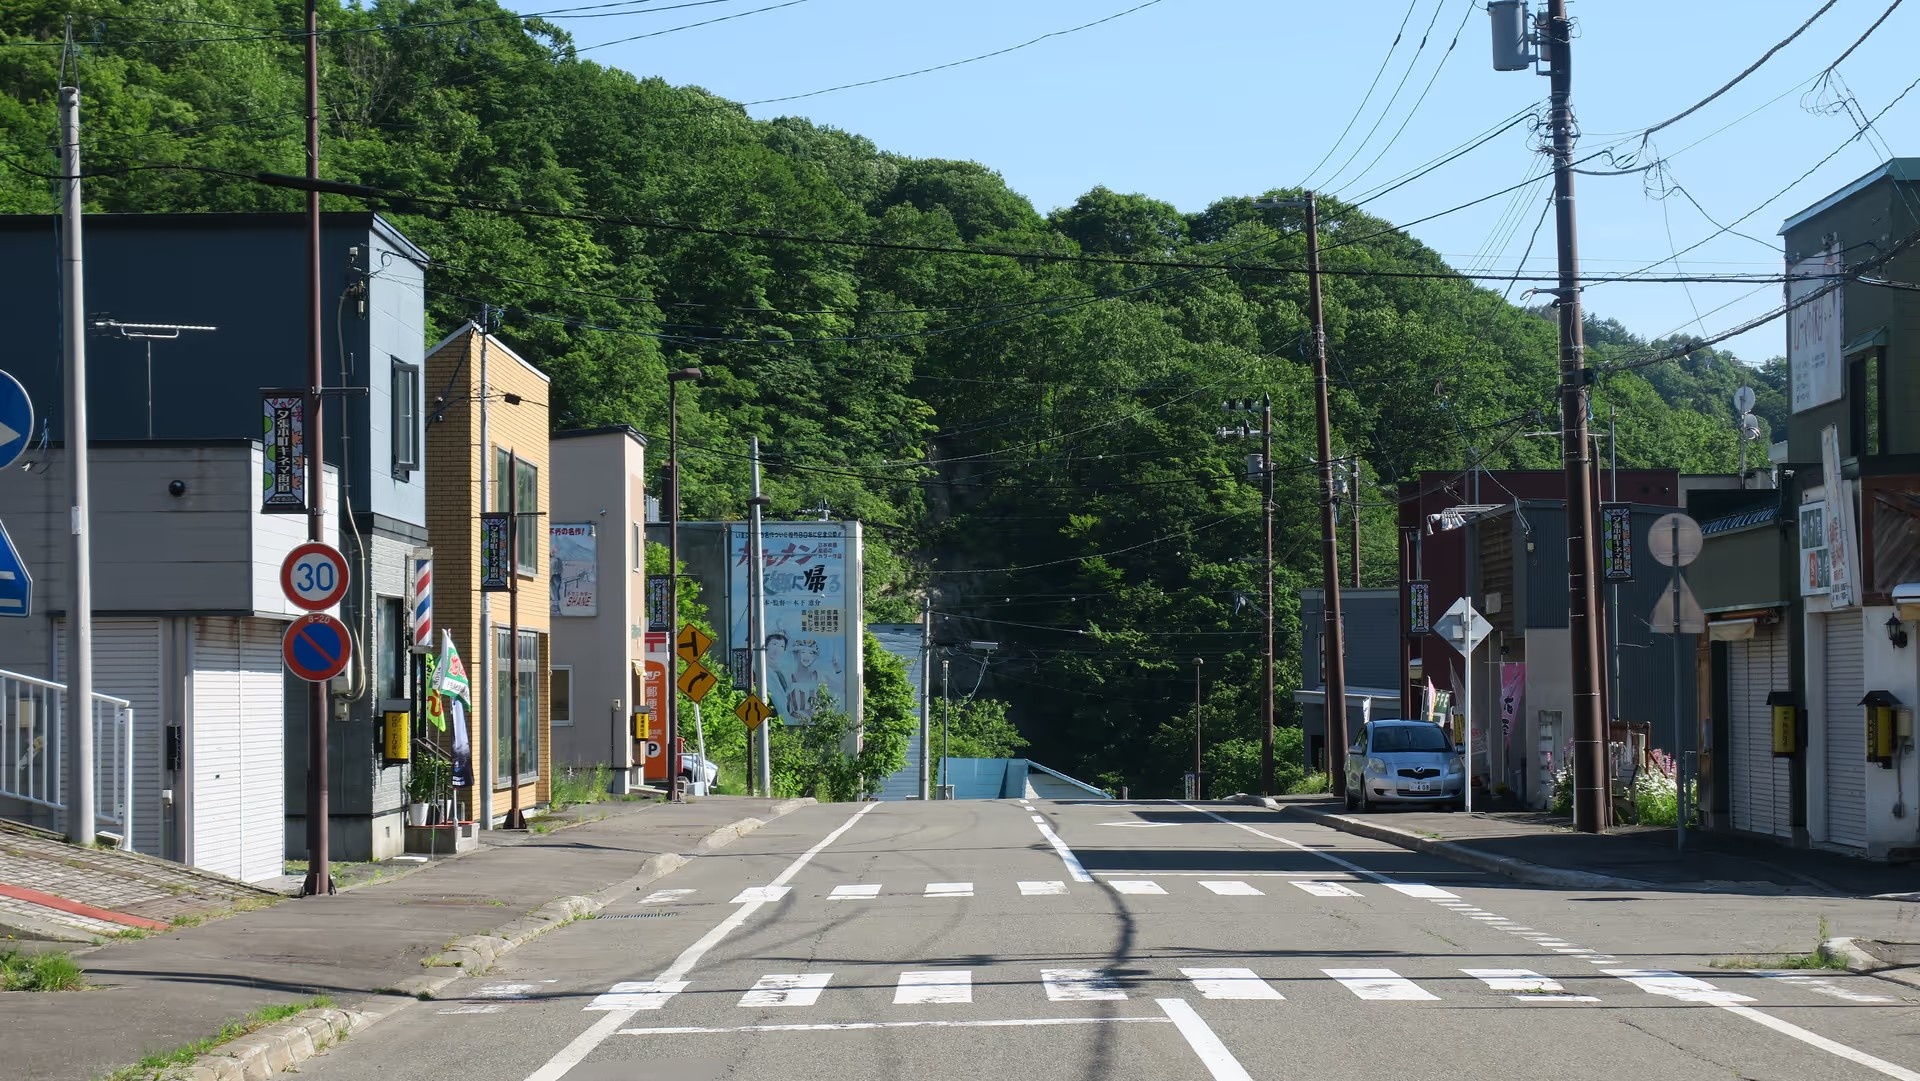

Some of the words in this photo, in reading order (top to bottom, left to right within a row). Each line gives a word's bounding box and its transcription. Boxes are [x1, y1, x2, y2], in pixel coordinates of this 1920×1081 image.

[276, 410, 291, 492] 夕張本町キネマ街道
[297, 562, 334, 592] 30
[566, 596, 592, 607] SHANE
[307, 614, 331, 624] 8-20
[646, 686, 658, 721] 郵便局
[648, 743, 658, 756] P
